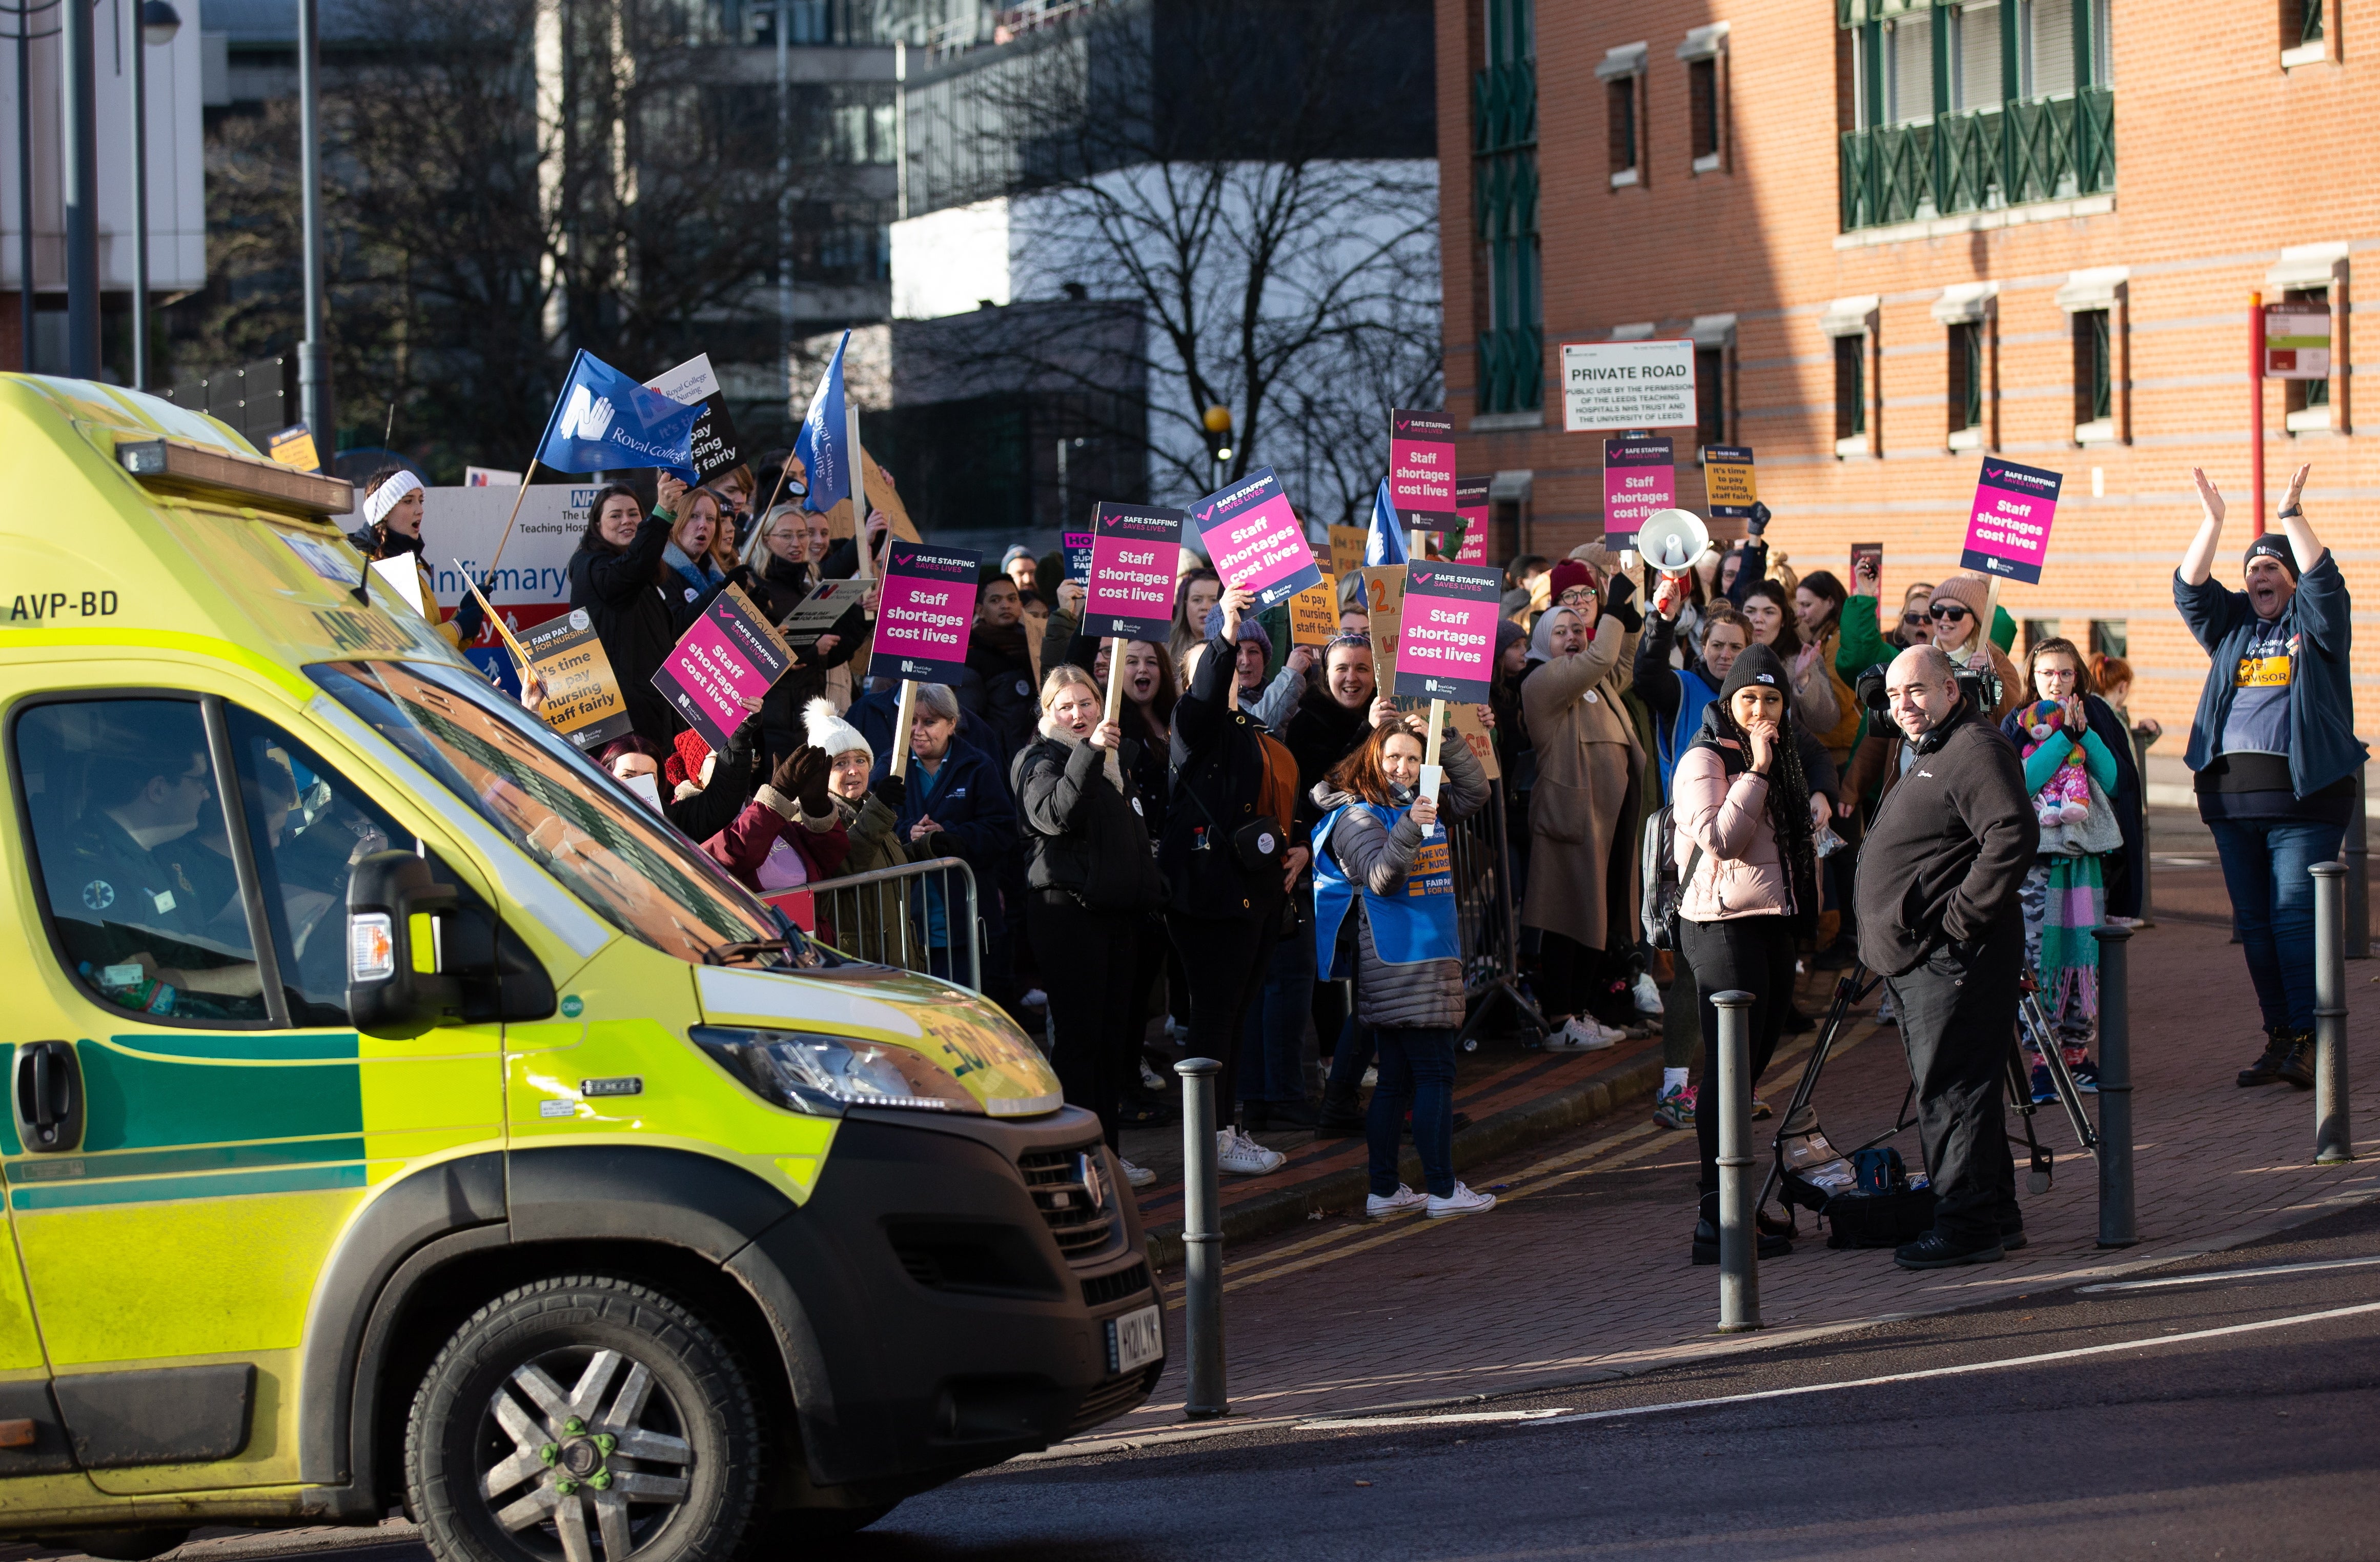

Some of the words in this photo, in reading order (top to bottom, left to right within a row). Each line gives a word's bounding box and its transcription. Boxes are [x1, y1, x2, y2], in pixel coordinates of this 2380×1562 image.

[1572, 367, 1637, 380] PRIVATE
[1642, 364, 1686, 377] ROAD
[666, 384, 683, 398] Royal
[683, 373, 707, 388] College
[1644, 383, 1694, 392] PERMISSION
[677, 386, 703, 403] Nursing
[1640, 393, 1680, 401] TEACHING
[1576, 405, 1620, 414] HOSPITALS
[1596, 414, 1642, 422] UNIVERSITY
[649, 445, 687, 464] College
[814, 407, 831, 441] Royal
[825, 443, 835, 491] College
[703, 446, 737, 471] fairly
[1410, 452, 1437, 464] Staff
[1396, 467, 1450, 482] shortages
[1625, 476, 1654, 488] Staff
[2004, 471, 2022, 480] SAFE
[2023, 474, 2056, 488] STAFFING
[1398, 484, 1421, 495] cost
[1423, 484, 1448, 497] lives
[1716, 484, 1747, 492] nursing
[2003, 477, 2025, 486] SAVES
[2026, 481, 2044, 491] LIVES
[1216, 492, 1237, 509] SAFE
[1236, 475, 1273, 499] STAFFING
[1611, 492, 1669, 504] shortages
[1733, 493, 1754, 501] fairly
[1219, 499, 1243, 514] SAVES
[1244, 488, 1265, 502] LIVES
[1997, 500, 2031, 517] Staff
[562, 511, 579, 520] The
[1614, 508, 1638, 518] cost
[520, 522, 562, 534] Teaching
[1143, 518, 1177, 526] STAFFING
[1977, 512, 2043, 536] shortages
[1231, 516, 1268, 544] Staff
[1976, 528, 2005, 543] cost
[2006, 533, 2037, 550] lives
[1219, 525, 1295, 570] shortages
[1463, 548, 1481, 559] lives
[917, 555, 937, 564] SAFE
[938, 558, 975, 568] STAFFING
[1118, 551, 1154, 565] Staff
[1230, 560, 1263, 583] cost
[1263, 542, 1299, 567] lives
[916, 562, 940, 571] SAVES
[941, 564, 962, 573] LIVES
[430, 560, 567, 598] Infirmary
[1099, 567, 1169, 585] shortages
[1434, 574, 1455, 583] SAFE
[1456, 576, 1494, 587] STAFFING
[1434, 580, 1458, 590] SAVES
[1460, 583, 1482, 592] LIVES
[909, 591, 949, 606] Staff
[1099, 587, 1128, 599] cost
[1131, 587, 1164, 602] lives
[1300, 593, 1310, 603] to
[1312, 596, 1326, 607] pay
[11, 590, 118, 621] AVP-BD
[887, 606, 964, 627] shortages
[1299, 608, 1332, 623] nursing
[1430, 609, 1469, 624] Staff
[532, 633, 552, 645] FAIR
[552, 626, 567, 638] PAY
[887, 626, 920, 640] cost
[923, 628, 958, 644] lives
[1296, 623, 1315, 633] staff
[1317, 624, 1339, 636] fairly
[1408, 625, 1486, 646] shortages
[535, 640, 553, 653] FOR
[730, 624, 750, 646] SAVES
[749, 645, 766, 664] LIVES
[735, 620, 751, 639] SAFE
[749, 637, 779, 670] STAFFING
[1409, 645, 1442, 659] cost
[1445, 646, 1481, 663] lives
[558, 653, 591, 671] time
[712, 645, 745, 679] Staff
[565, 669, 590, 689] pay
[688, 643, 746, 707] shortages
[681, 658, 707, 687] cost
[706, 683, 734, 717] lives
[547, 682, 602, 711] nursing
[545, 705, 576, 726] staff
[579, 693, 615, 715] fairly
[1417, 850, 1434, 861] THE
[1412, 862, 1425, 872] OF
[1426, 879, 1443, 887] FAIR
